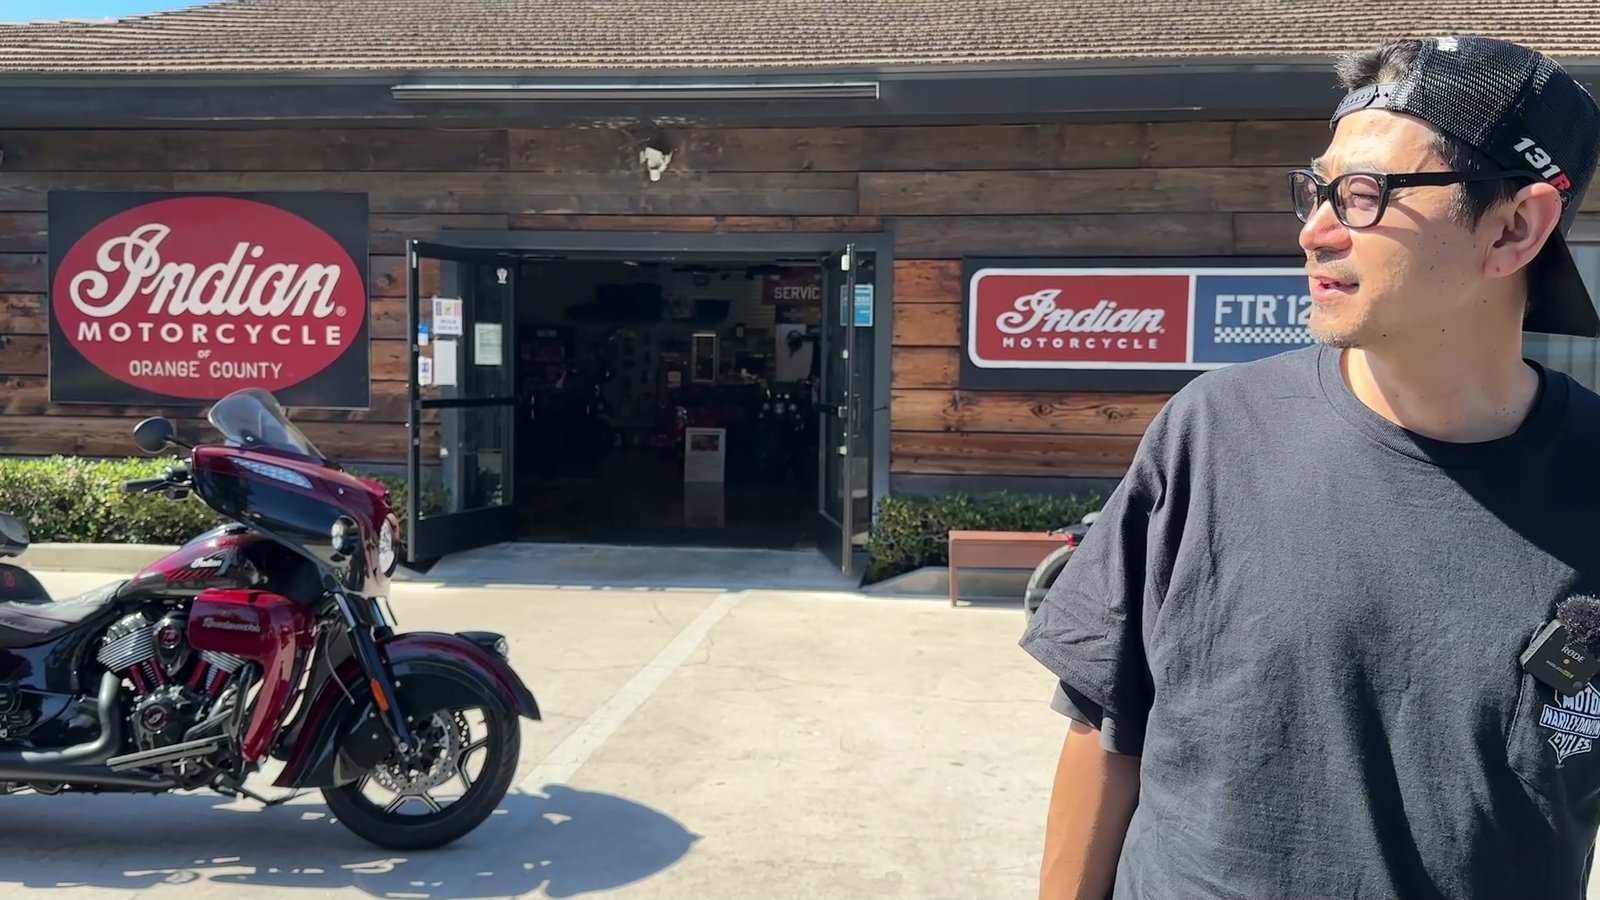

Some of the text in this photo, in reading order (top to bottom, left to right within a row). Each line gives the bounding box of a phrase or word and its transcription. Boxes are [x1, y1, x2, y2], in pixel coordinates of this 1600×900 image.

[1513, 137, 1571, 191] 131R
[69, 222, 341, 319] Indian
[774, 286, 821, 300] SERVIC
[995, 288, 1167, 335] Indian
[1214, 294, 1312, 325] FTR 12
[77, 322, 342, 346] MOTORCYCLE
[1002, 336, 1159, 350] MOTORCYCLE
[197, 349, 212, 359] OF
[129, 360, 283, 380] ORANGE COUNTY
[1553, 732, 1591, 758] CYCLES
